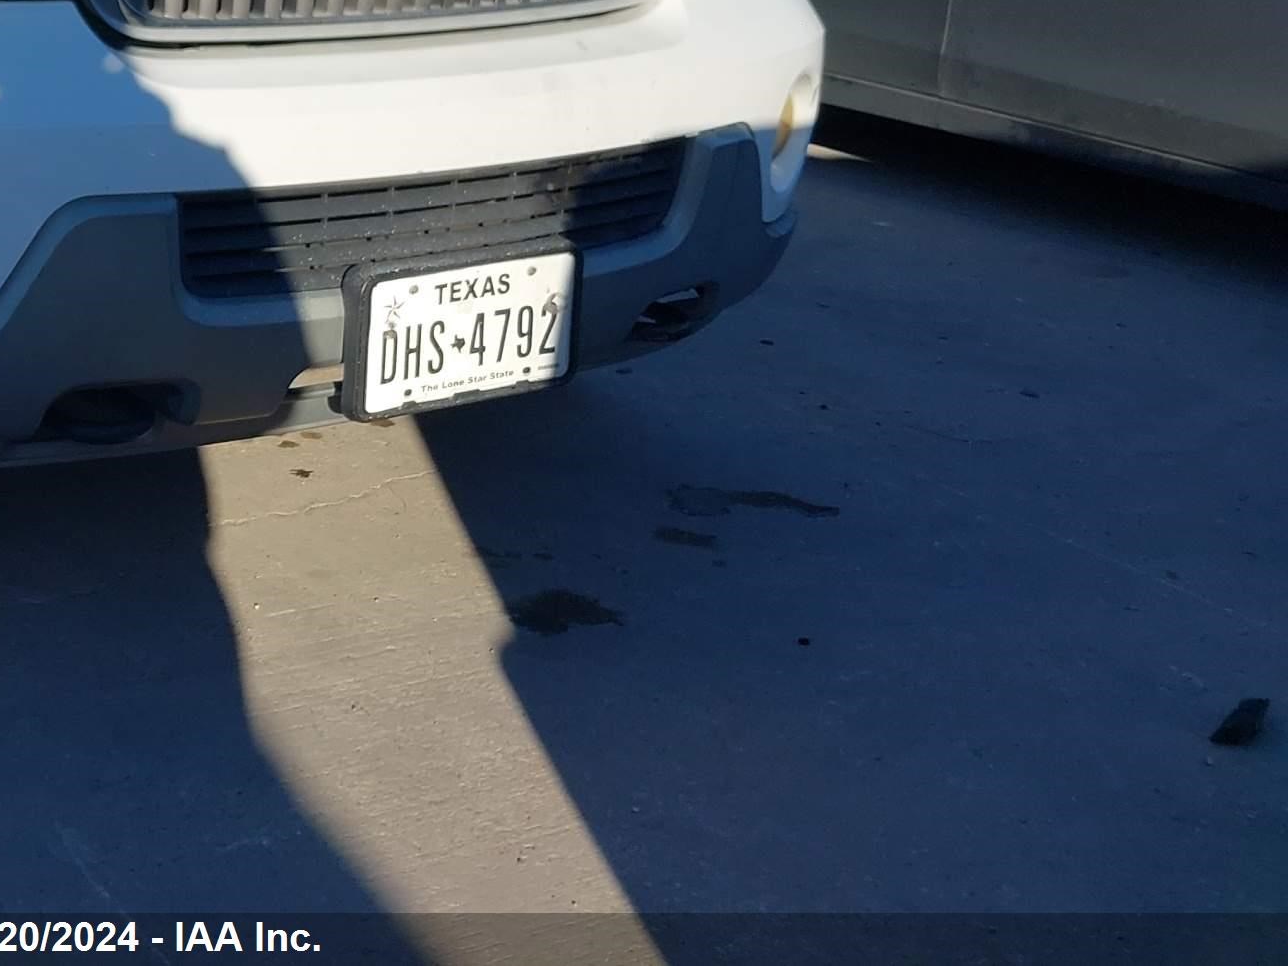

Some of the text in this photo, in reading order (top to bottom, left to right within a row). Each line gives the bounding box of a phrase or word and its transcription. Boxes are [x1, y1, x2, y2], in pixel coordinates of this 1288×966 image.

[434, 273, 511, 305] TEXAS
[421, 369, 515, 394] The Lone Star State
